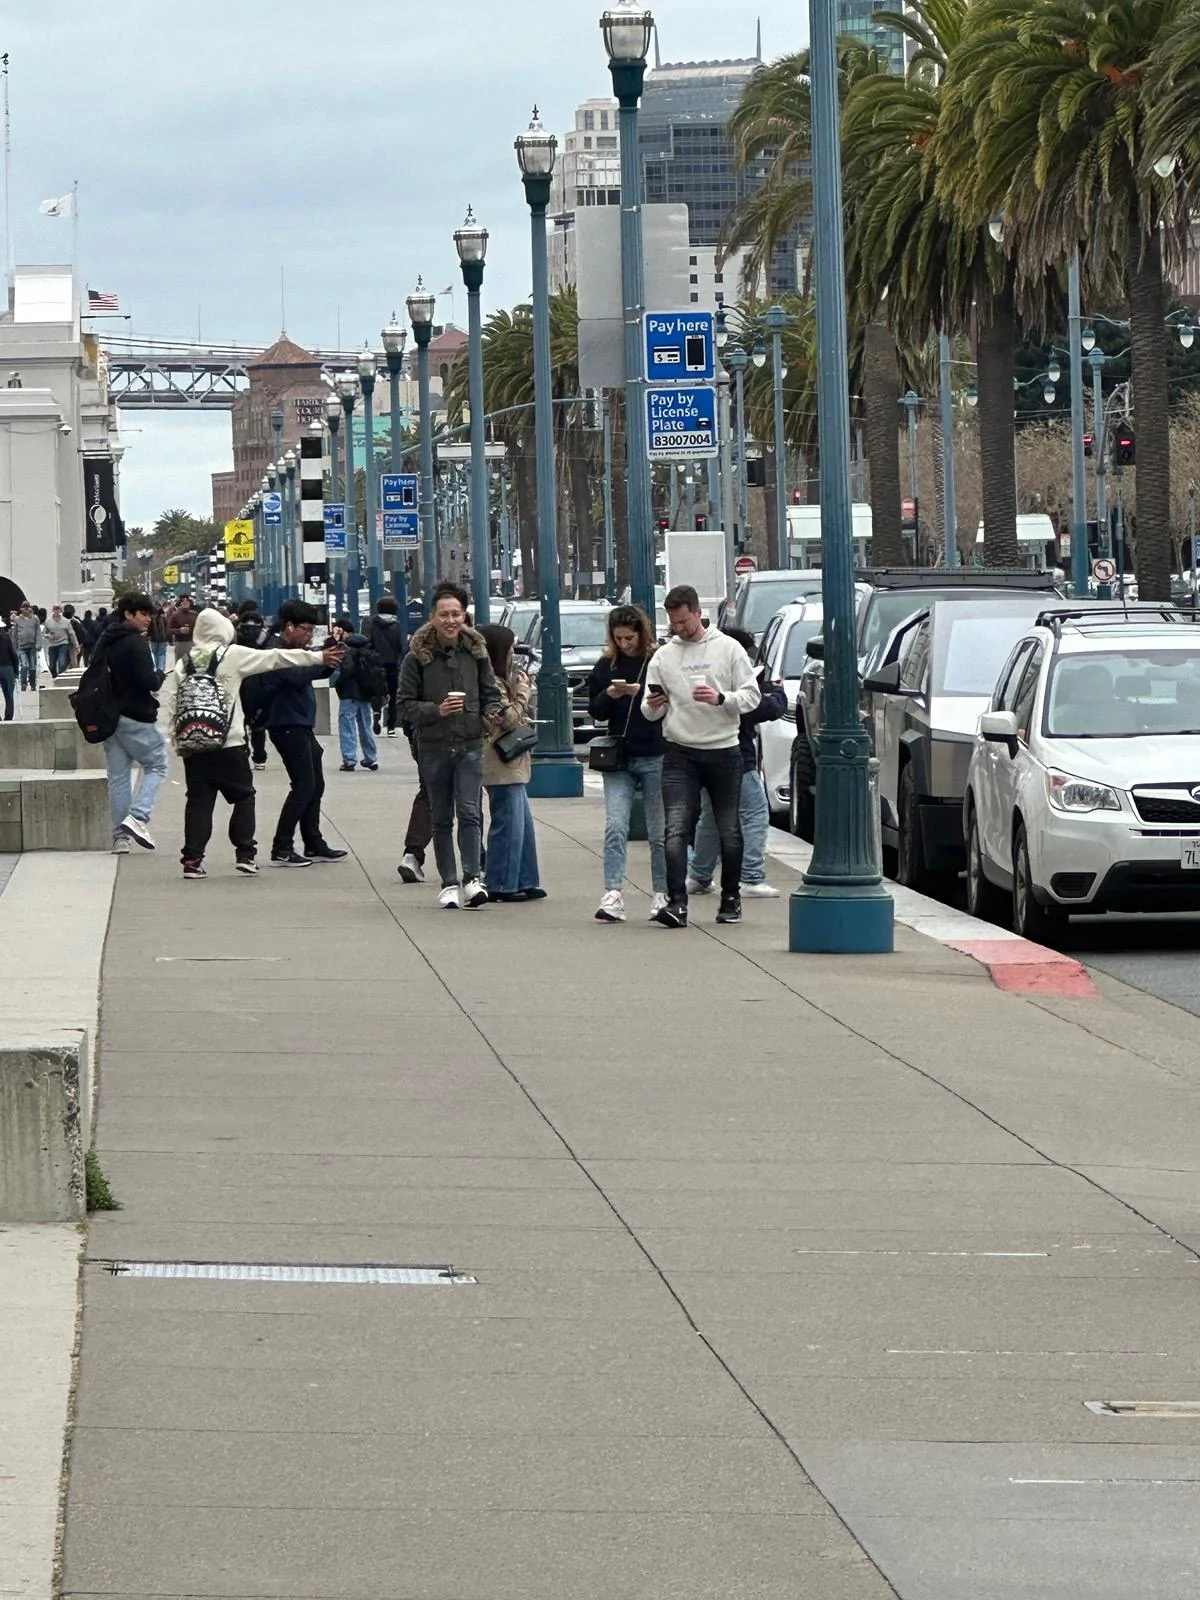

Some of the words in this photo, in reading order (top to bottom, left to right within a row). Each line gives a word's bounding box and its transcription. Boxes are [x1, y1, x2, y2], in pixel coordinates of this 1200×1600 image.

[649, 320, 674, 335] Pay
[677, 319, 709, 332] here
[650, 394, 674, 408] Pay
[677, 393, 695, 407] by
[651, 407, 699, 418] License
[652, 420, 685, 431] Plate
[654, 434, 711, 447] 83007004
[383, 479, 397, 487] Pay
[1185, 850, 1200, 865] 7L
